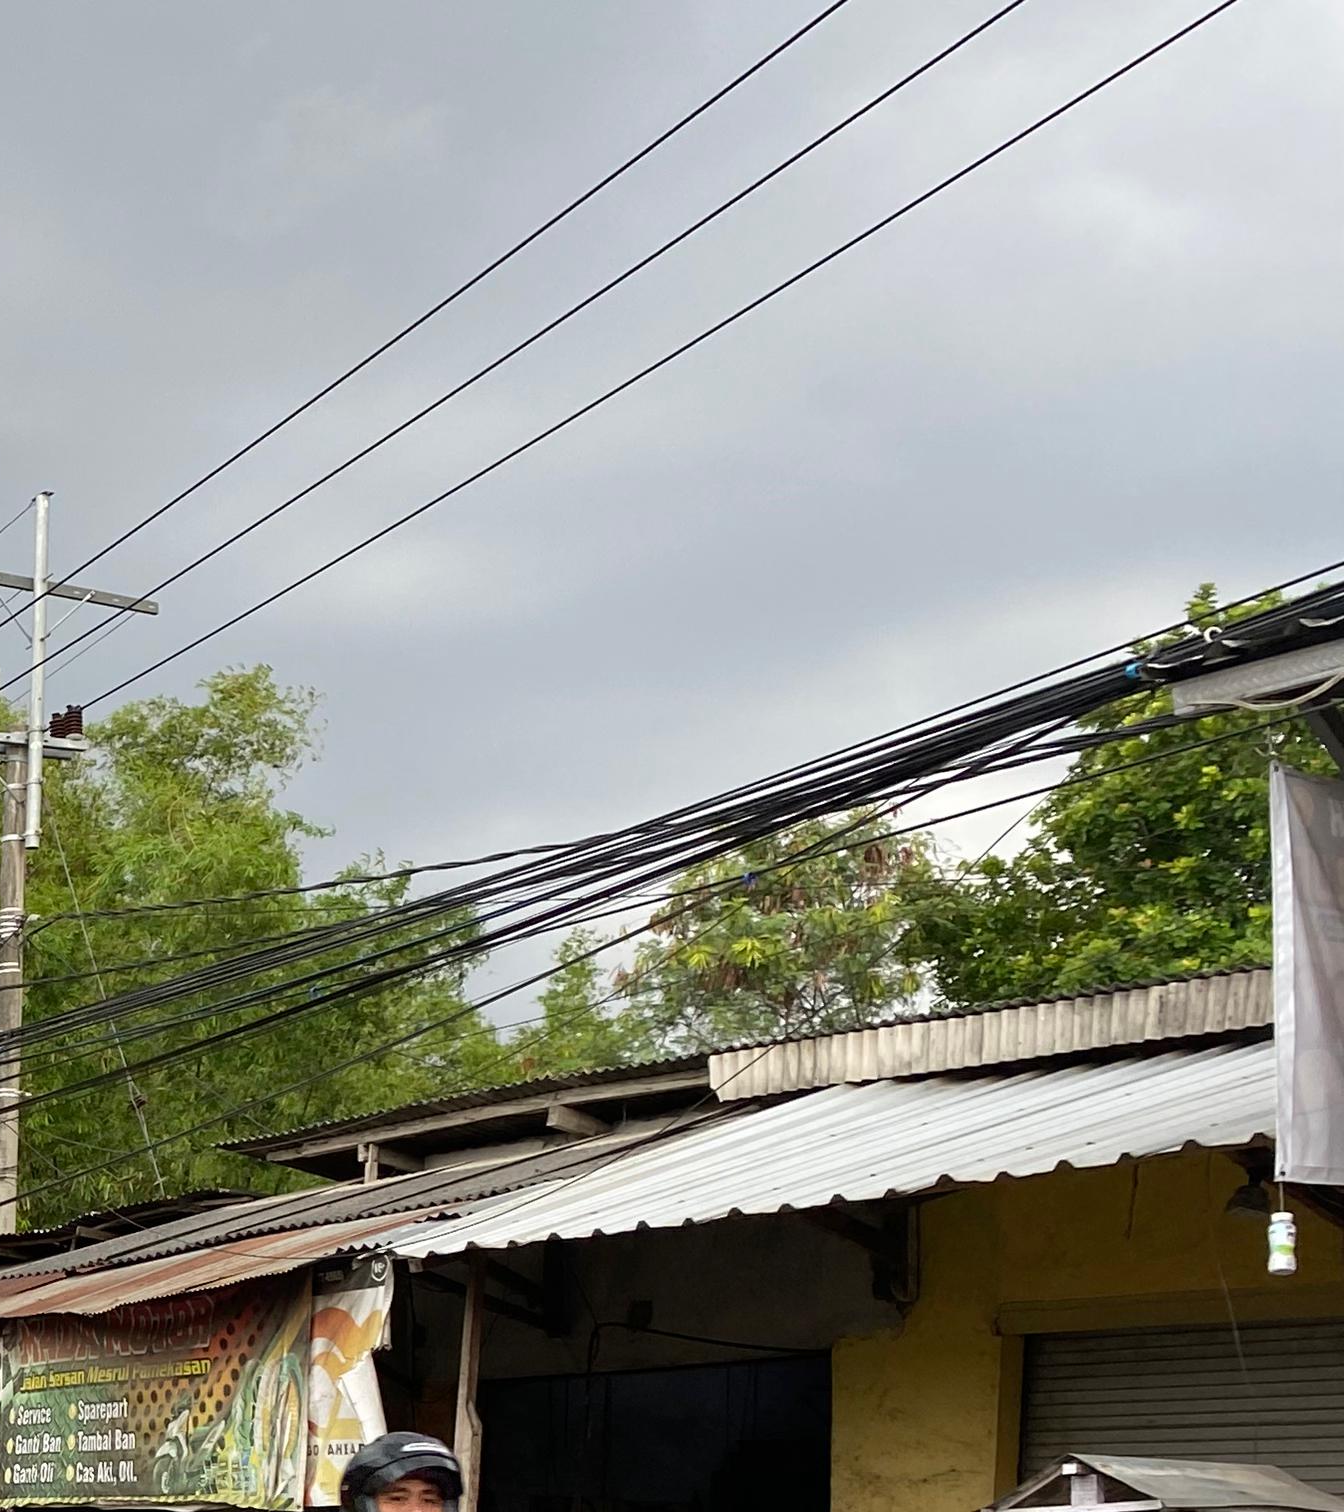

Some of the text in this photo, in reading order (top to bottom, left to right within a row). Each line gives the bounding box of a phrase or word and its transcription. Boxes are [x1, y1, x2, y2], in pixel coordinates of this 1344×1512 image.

[100, 1295, 214, 1356] MOTOR
[20, 1359, 212, 1392] Jalan Sersan Mesrul Pamekasan
[17, 1397, 128, 1426] Service Sparepart
[15, 1428, 136, 1455] Ganti Ban Tambal Ban
[13, 1463, 38, 1484] Ganti
[40, 1462, 55, 1483] Oli
[76, 1462, 95, 1483] Cas
